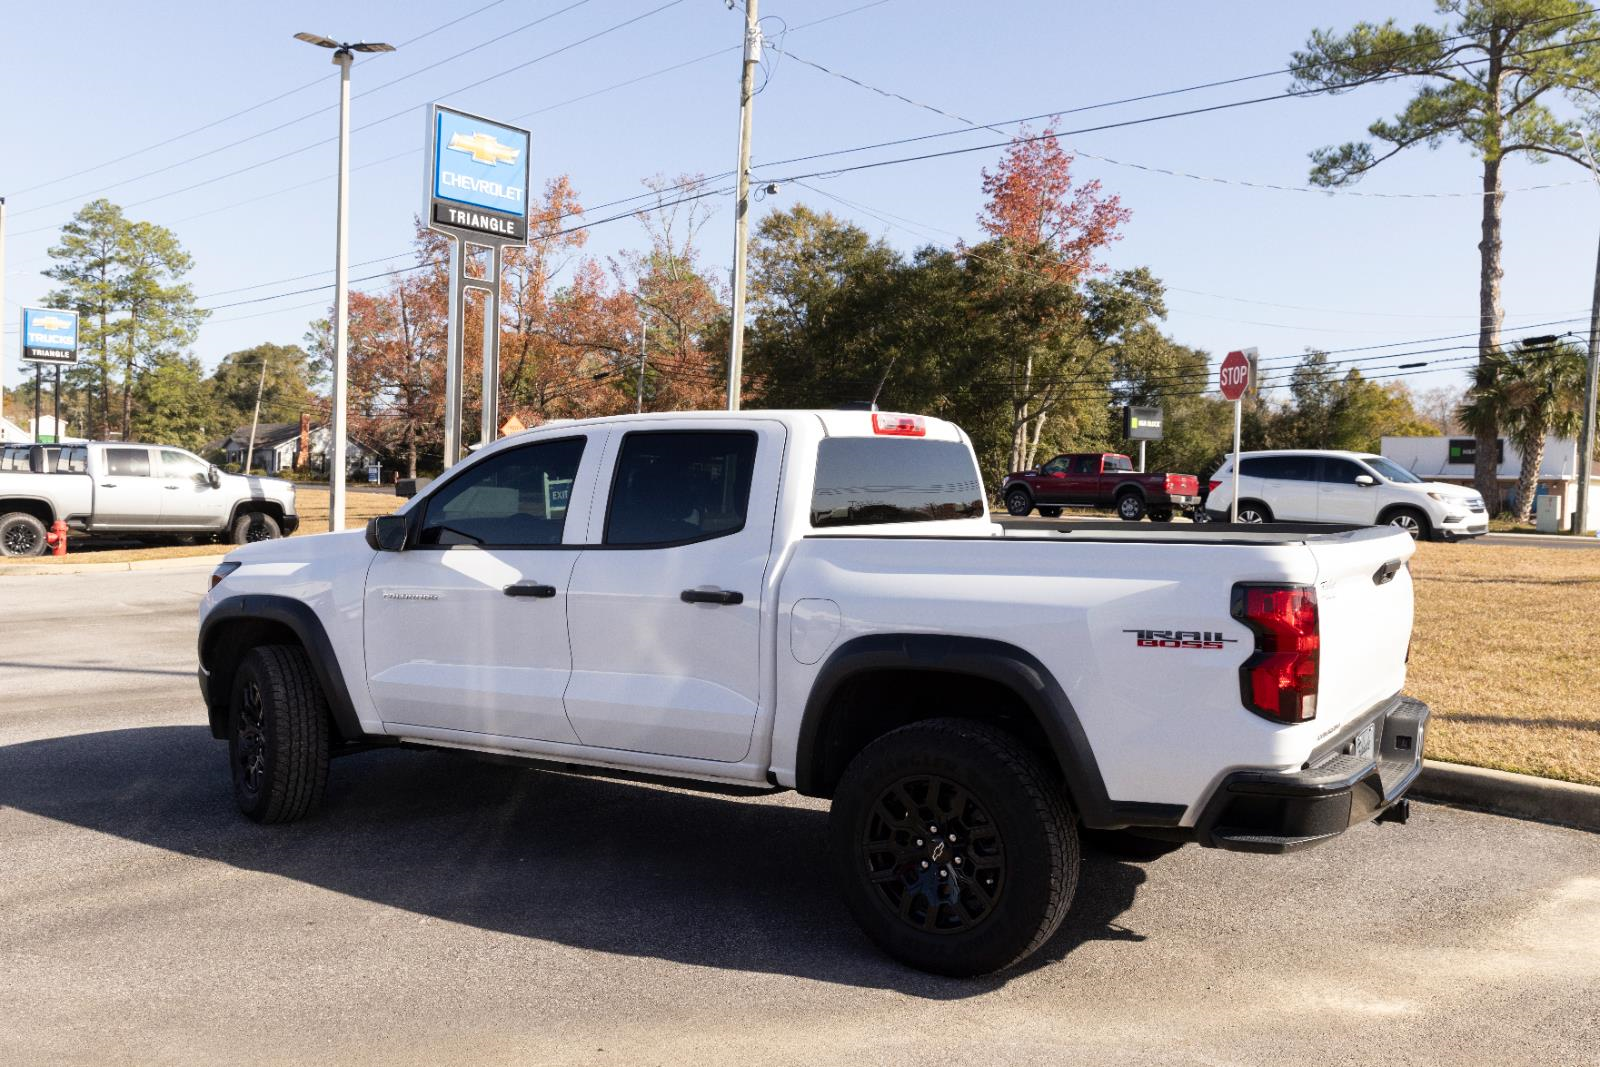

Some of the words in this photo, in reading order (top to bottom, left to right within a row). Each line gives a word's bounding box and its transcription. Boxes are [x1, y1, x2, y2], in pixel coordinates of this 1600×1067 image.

[442, 171, 523, 200] CHEVROLET
[449, 209, 515, 234] TRIANGLE
[28, 333, 74, 345] TRUCKS
[32, 349, 70, 358] TRIANGLE
[1221, 365, 1247, 386] STOP
[552, 490, 568, 500] EXIT
[1122, 629, 1238, 642] TRAIL
[1137, 639, 1224, 649] BOSS
